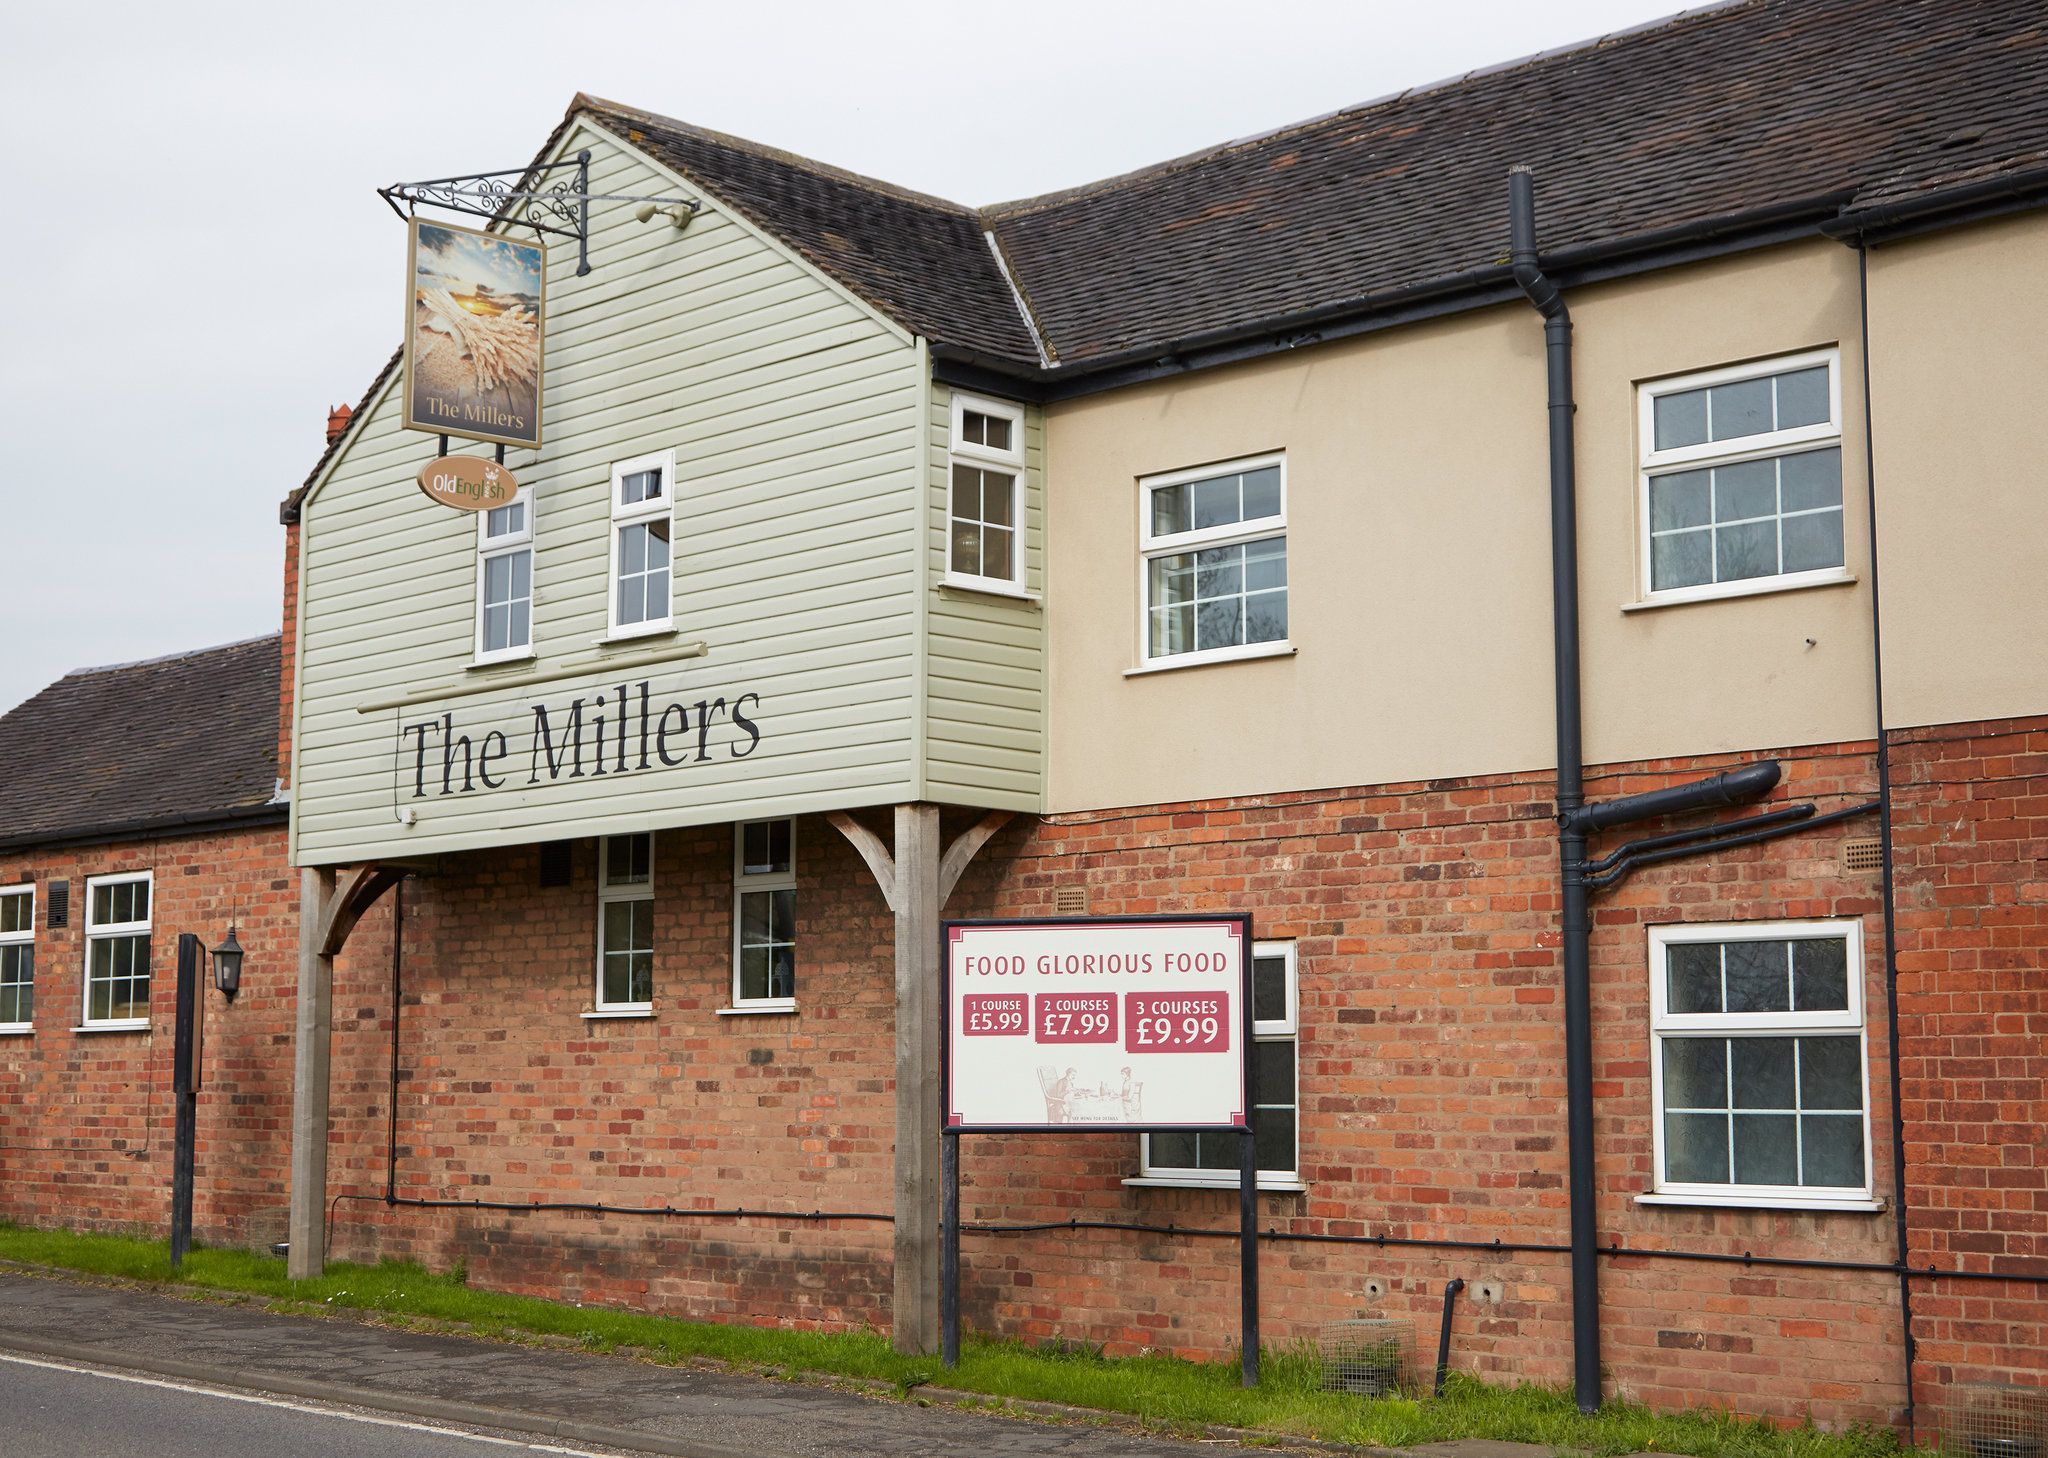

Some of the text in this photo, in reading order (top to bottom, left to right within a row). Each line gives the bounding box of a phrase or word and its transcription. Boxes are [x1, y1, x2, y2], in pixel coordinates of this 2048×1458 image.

[426, 396, 524, 429] The Millers
[402, 680, 760, 798] The Millers
[965, 951, 1228, 976] FOOD GLORIOUS FOOD
[971, 1000, 1022, 1011] 1 COURSE
[1044, 999, 1109, 1012] 2 COURSES
[1136, 1000, 1218, 1015] 3 COURSES
[969, 1012, 1022, 1031] £5.99
[1043, 1013, 1110, 1036] £7.99
[1136, 1017, 1219, 1045] £9.99
